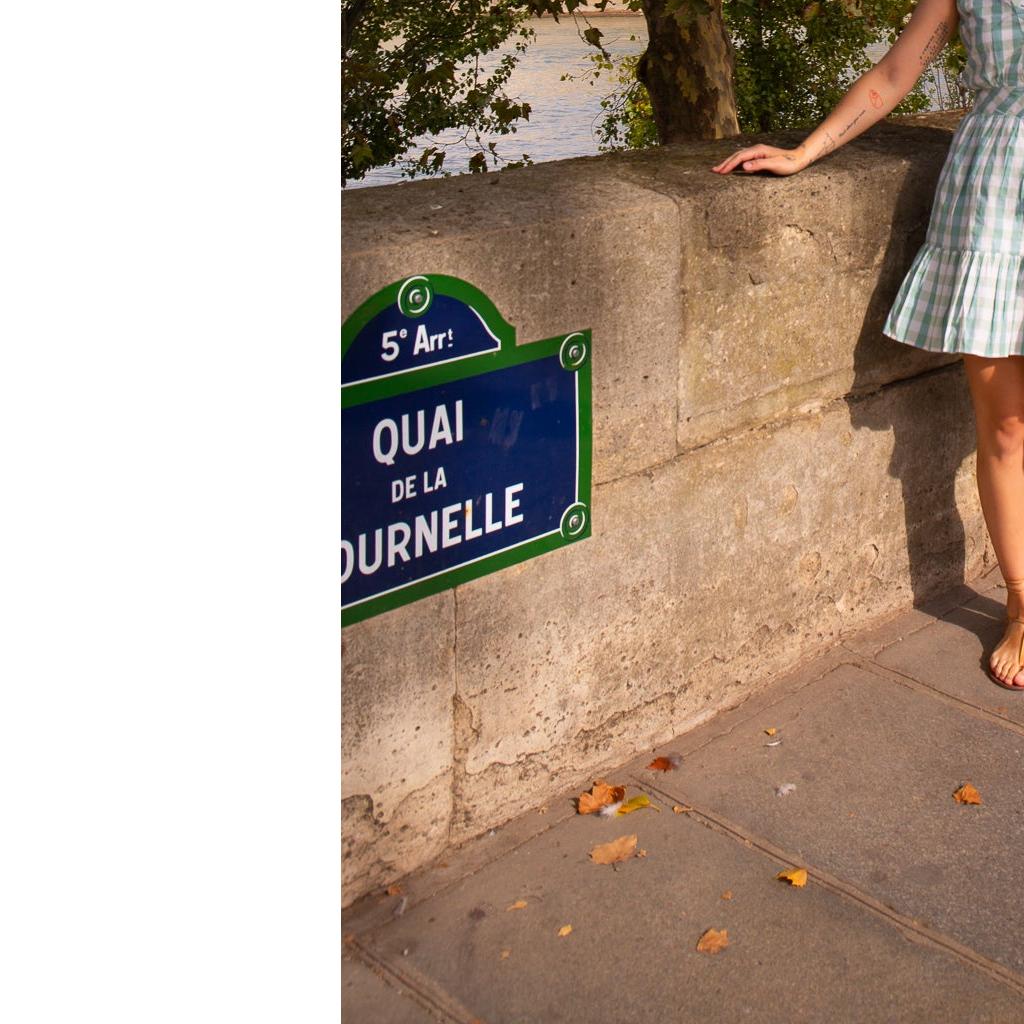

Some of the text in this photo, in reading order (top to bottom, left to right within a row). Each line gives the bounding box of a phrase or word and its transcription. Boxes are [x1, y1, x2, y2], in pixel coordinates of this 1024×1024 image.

[372, 400, 463, 465] QUAI
[391, 466, 447, 503] DE LA
